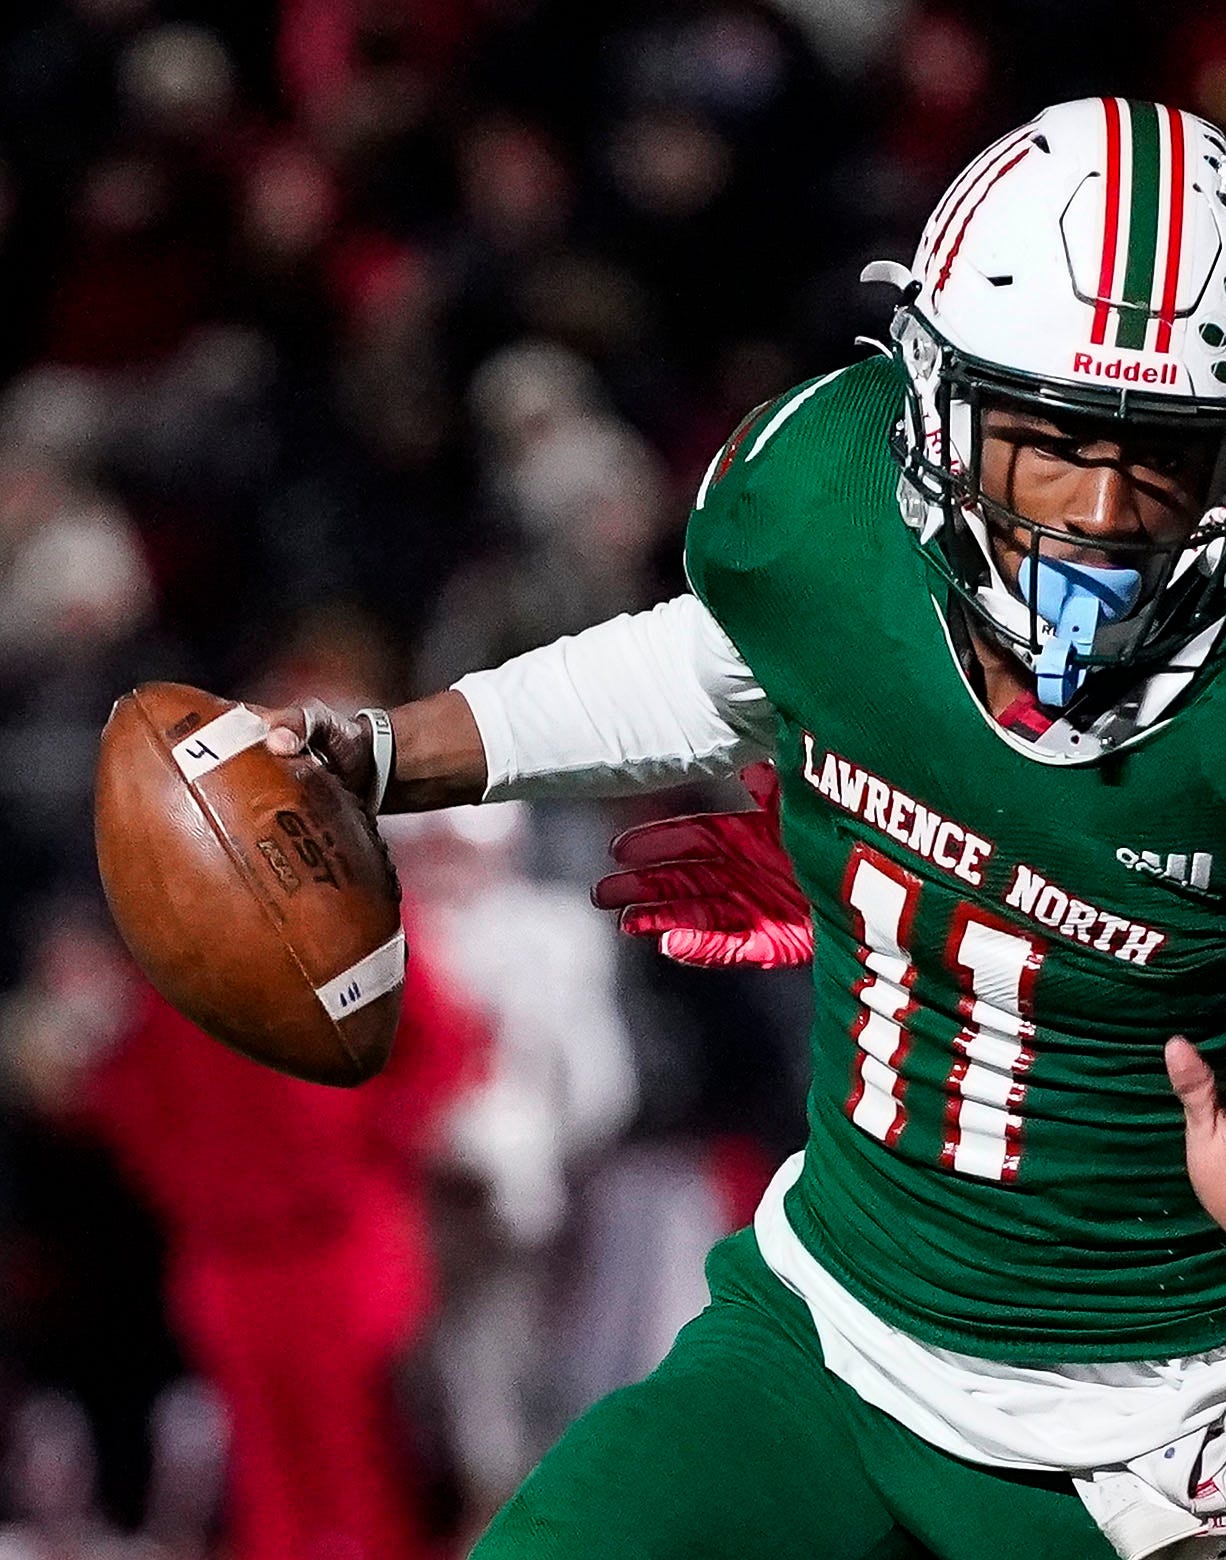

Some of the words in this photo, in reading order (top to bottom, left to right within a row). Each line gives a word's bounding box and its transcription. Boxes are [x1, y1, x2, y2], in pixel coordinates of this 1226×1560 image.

[1073, 352, 1178, 385] Riddell
[801, 730, 994, 889] LAWRENCE
[1003, 864, 1168, 967] NORTH
[842, 842, 1047, 1184] 11
